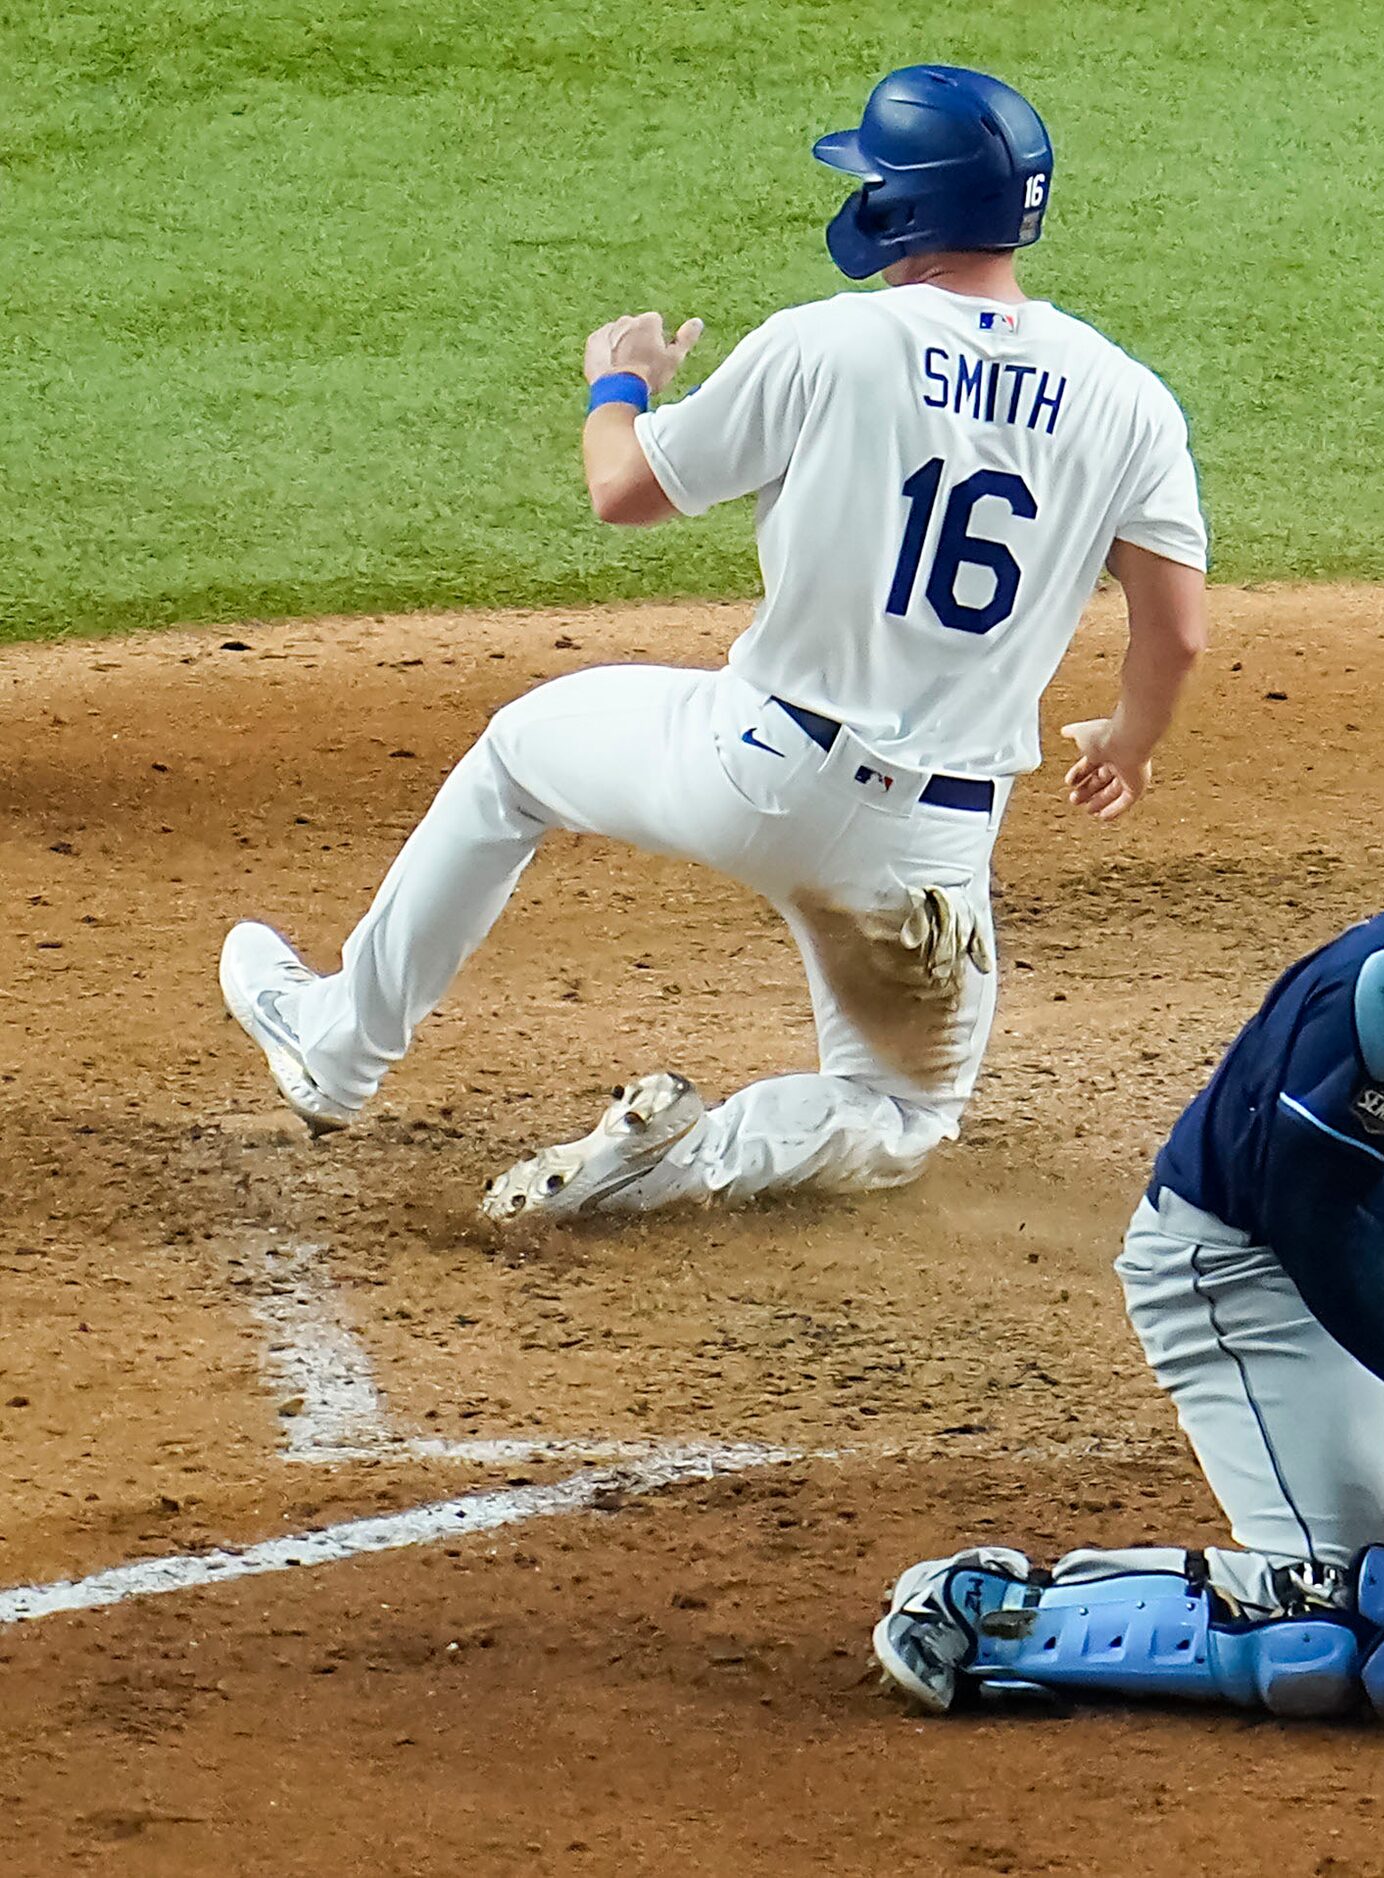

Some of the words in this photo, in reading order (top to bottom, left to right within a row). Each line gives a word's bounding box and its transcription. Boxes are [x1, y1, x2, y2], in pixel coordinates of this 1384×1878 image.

[1024, 173, 1046, 209] 16
[923, 347, 1067, 435] SMITH
[885, 457, 1038, 635] 16
